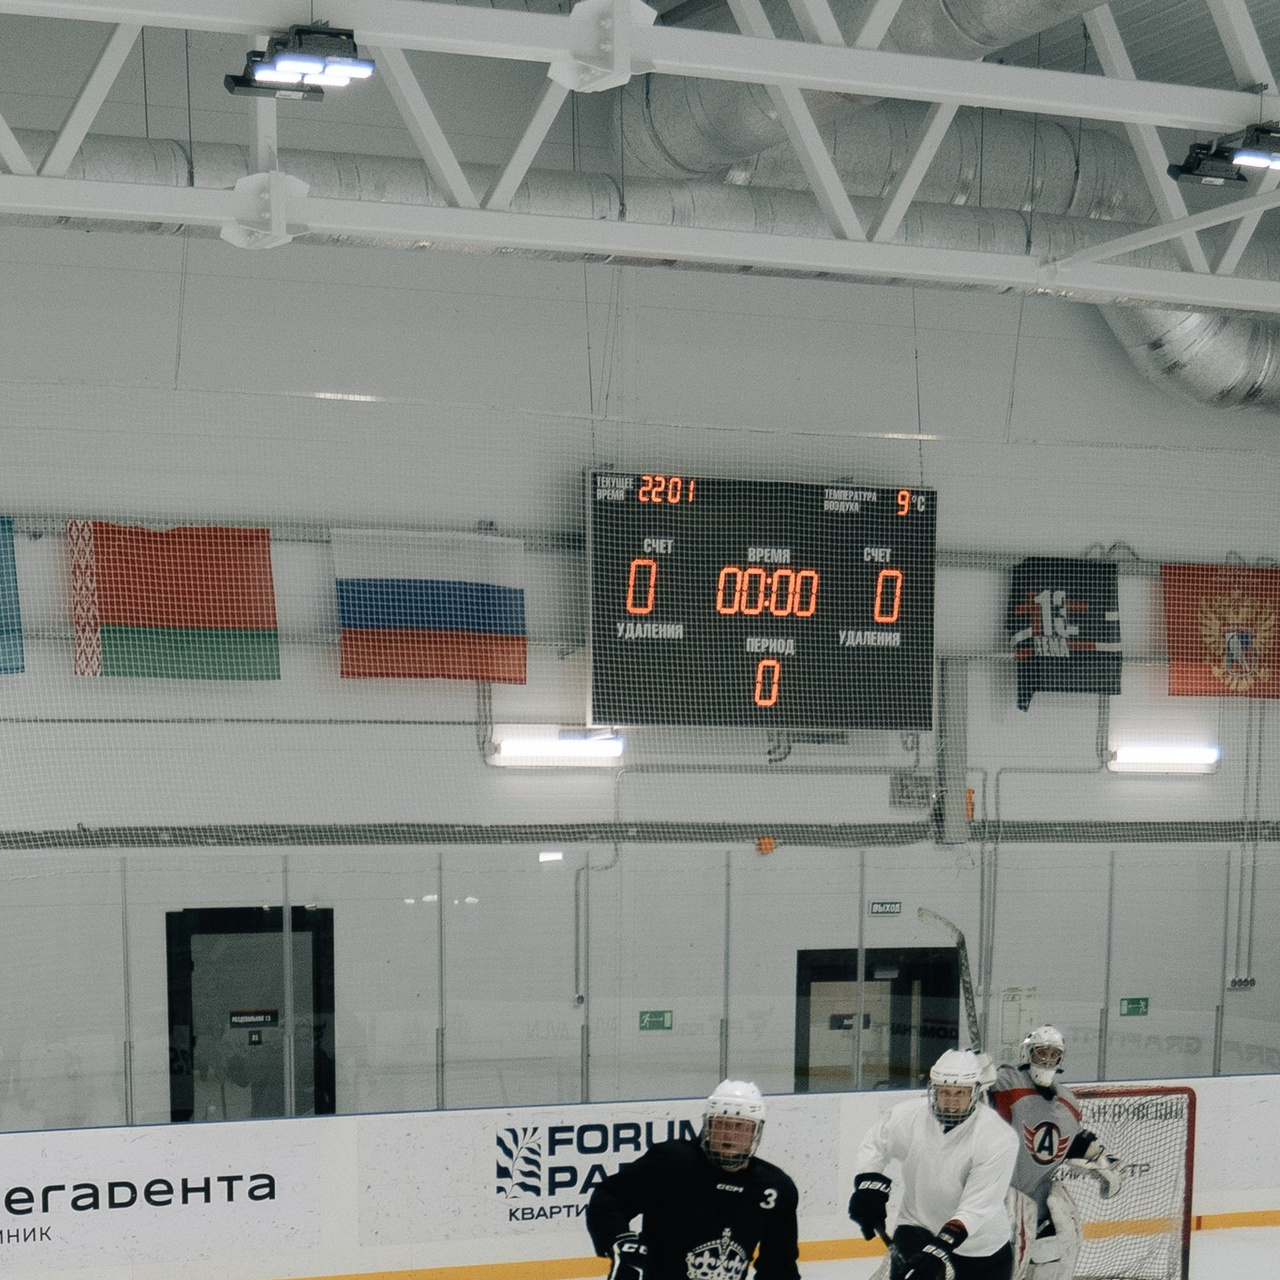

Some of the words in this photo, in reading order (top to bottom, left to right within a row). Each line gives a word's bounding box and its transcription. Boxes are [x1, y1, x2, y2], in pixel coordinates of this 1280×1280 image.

[596, 476, 634, 490] ТЕКУЩЕЕ
[596, 489, 625, 501] ВРЕМЯ
[824, 489, 877, 502] ТЕМПЕРАТУРА
[897, 489, 910, 516] 9
[824, 500, 860, 513] ВОЗДУХА
[643, 538, 674, 554] СЧЕТ
[747, 547, 791, 564] ВРЕМЯ
[863, 547, 892, 563] СЧЕТ
[626, 558, 657, 615] 0
[716, 566, 819, 618] 00:00
[873, 569, 903, 624] 0
[616, 623, 684, 640] УДАЛЕНИЯ
[838, 629, 900, 647] УДАЛЕНИЯ
[746, 637, 795, 656] ПЕРИОД
[754, 659, 780, 707] 0
[872, 902, 901, 914] ВЫХОД
[548, 1162, 632, 1197] PA
[716, 1182, 744, 1194] CCM
[759, 1188, 778, 1210] 3
